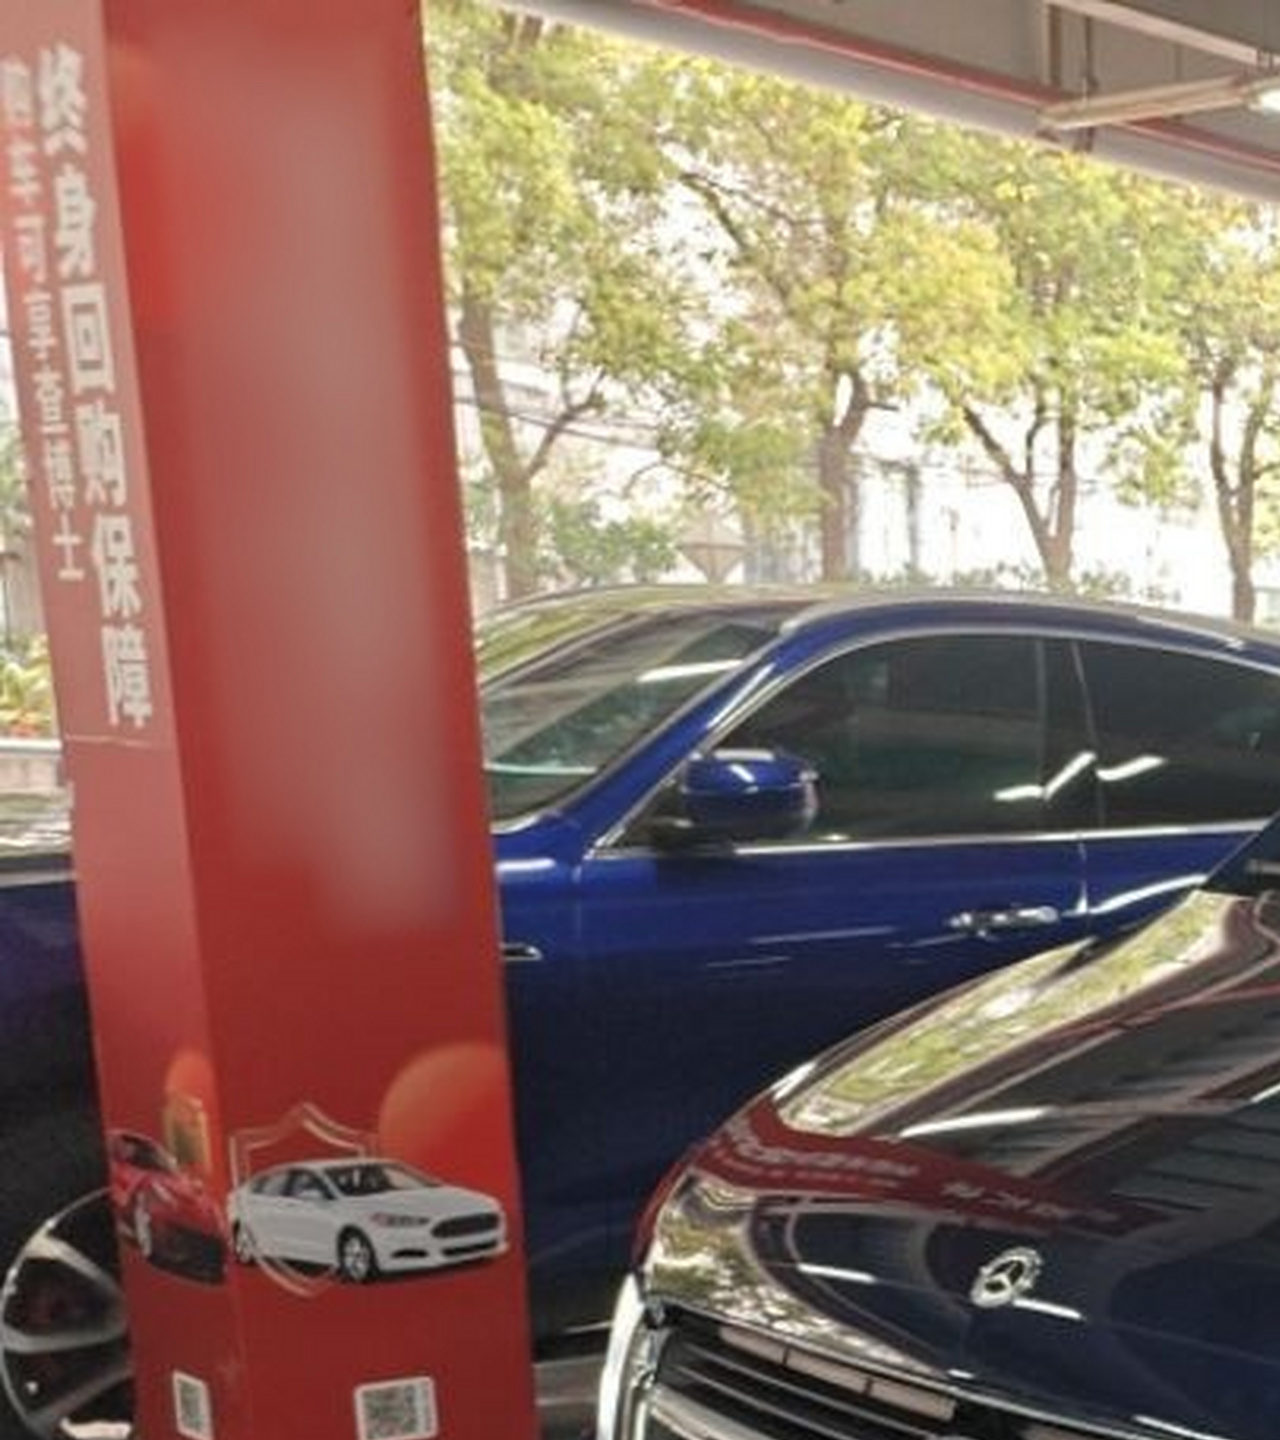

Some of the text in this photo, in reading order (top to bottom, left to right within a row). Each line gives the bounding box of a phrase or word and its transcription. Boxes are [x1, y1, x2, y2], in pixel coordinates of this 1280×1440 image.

[37, 44, 154, 730] 终身回购保障
